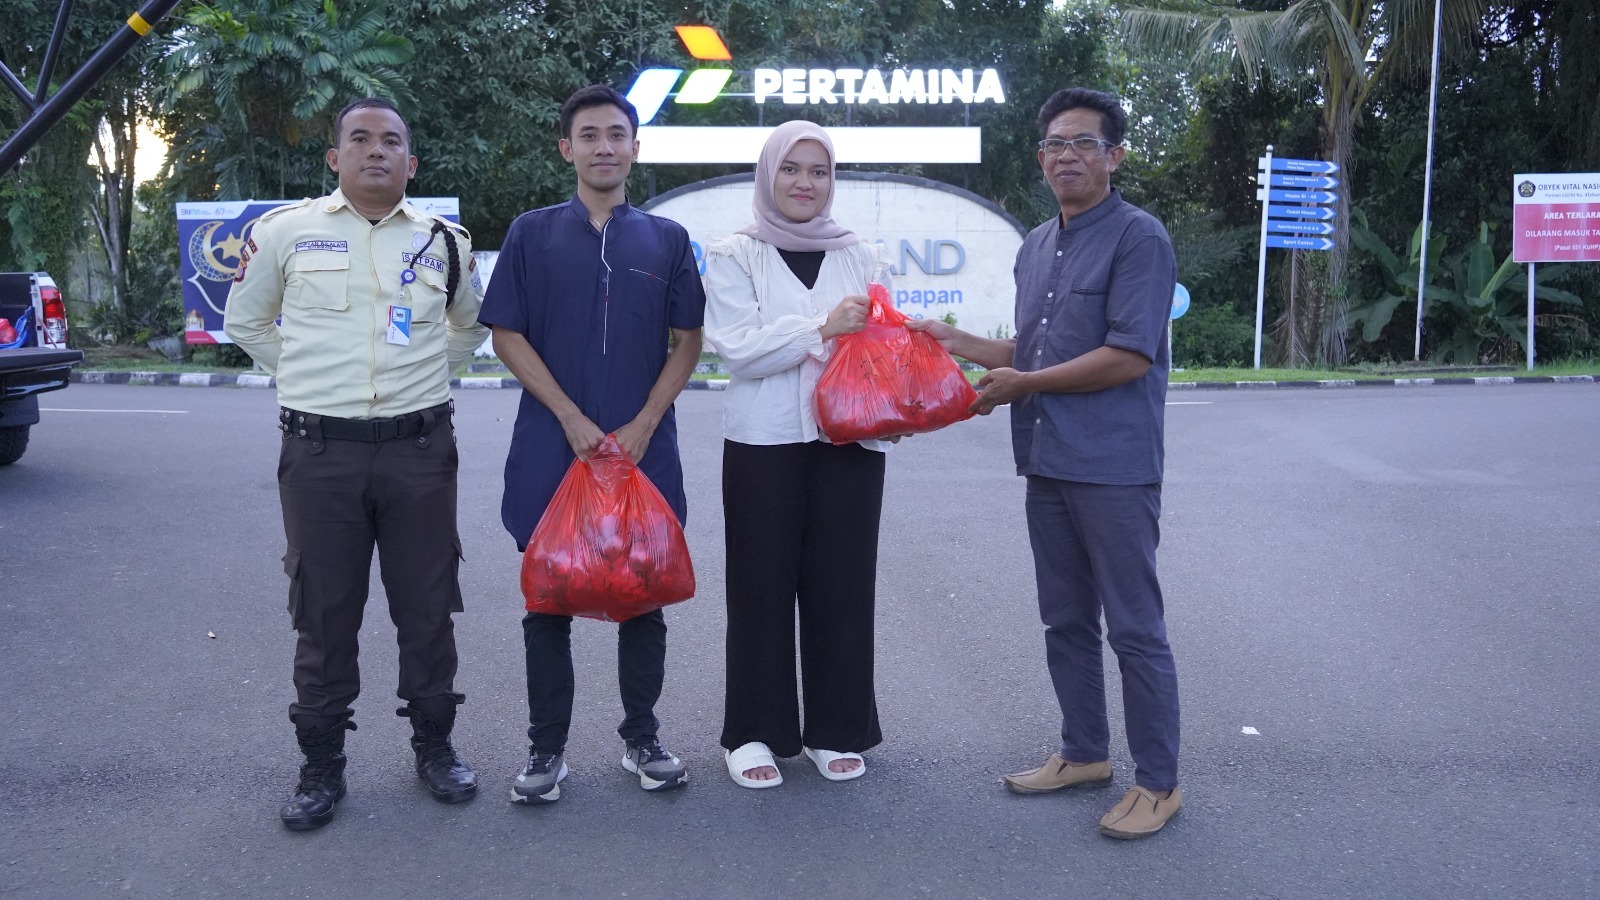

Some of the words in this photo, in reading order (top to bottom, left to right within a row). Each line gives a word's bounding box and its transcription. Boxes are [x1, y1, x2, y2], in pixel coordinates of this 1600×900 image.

[753, 68, 1006, 105] PERTAMINA
[1582, 182, 1600, 190] NASI
[1543, 212, 1564, 220] AREA
[1566, 211, 1600, 219] TERLARA
[1525, 230, 1562, 238] DILARANG
[1563, 229, 1590, 237] MASUK
[1554, 244, 1571, 252] (Pasal
[404, 254, 443, 271] STPAM
[893, 289, 963, 309] papan
